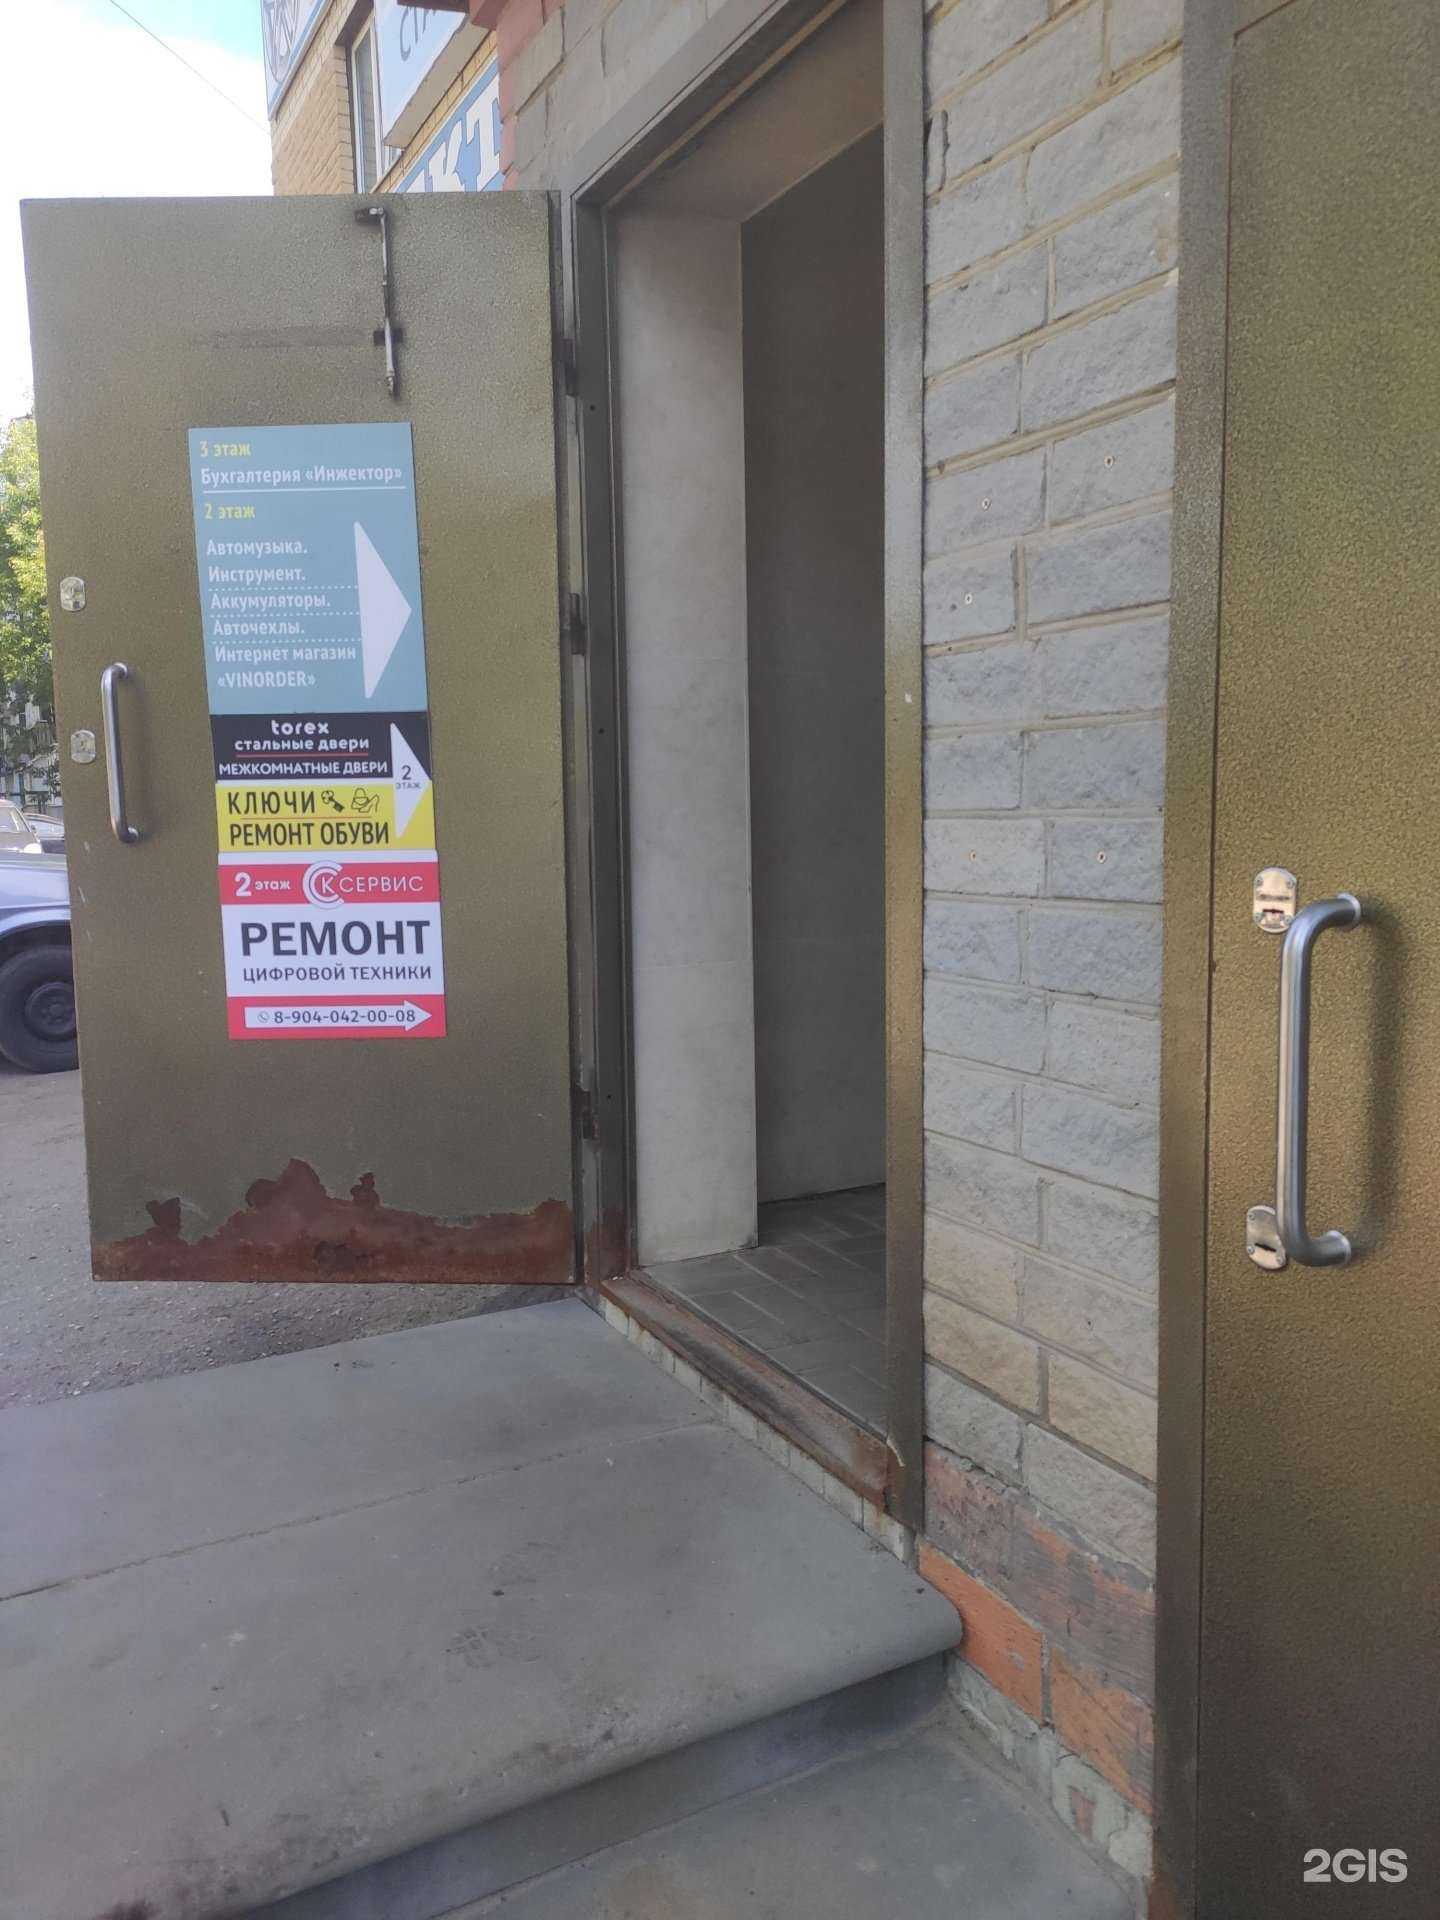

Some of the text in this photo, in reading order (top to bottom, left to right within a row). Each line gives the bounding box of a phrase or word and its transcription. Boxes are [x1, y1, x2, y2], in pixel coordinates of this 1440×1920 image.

[200, 441, 251, 457] 3 этаж
[201, 466, 402, 486] Бухгалтерия «Инжектор»
[205, 504, 255, 519] 2 этаж
[207, 540, 308, 558] Автомузыка.
[209, 567, 305, 585] Инструмент.
[211, 594, 330, 612] Аккумуляторы.
[214, 620, 304, 636] Авточехлы.
[215, 647, 356, 664] Интернет магазин
[217, 672, 315, 688] «VINORDER»
[271, 720, 329, 734] torex
[235, 738, 370, 752] стальные двери
[219, 762, 388, 776] МЕЖКОМНАТНЫЕ ДВЕРИ
[402, 765, 412, 780] 2
[396, 782, 421, 790] ЭТАЖ
[228, 791, 315, 815] КЛЮЧИ
[230, 822, 389, 847] РЕМОНТ ОБУВИ
[235, 872, 252, 897] 2
[255, 880, 291, 891] этаж
[241, 920, 430, 957] РЕМОНТ
[244, 964, 432, 983] ЦИФРОВОЙ ТЕХНИКИ
[274, 1010, 416, 1024] 8-904-042-00-08
